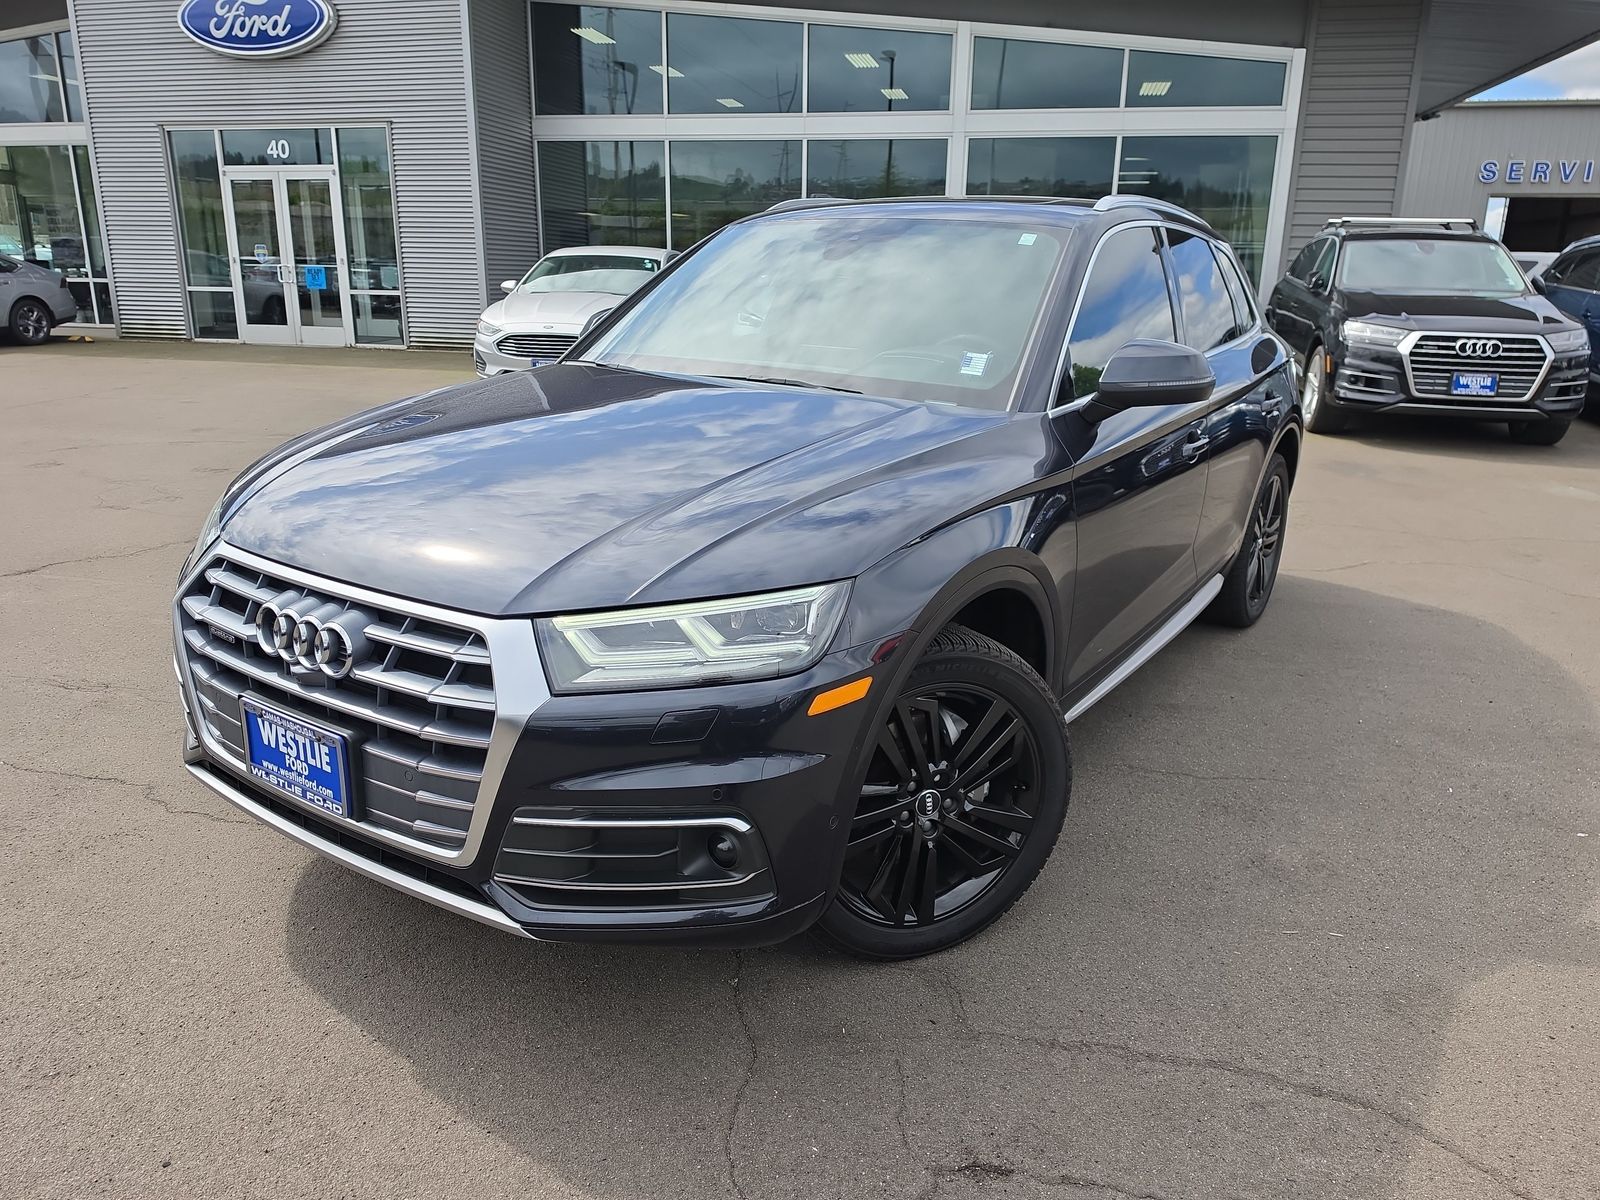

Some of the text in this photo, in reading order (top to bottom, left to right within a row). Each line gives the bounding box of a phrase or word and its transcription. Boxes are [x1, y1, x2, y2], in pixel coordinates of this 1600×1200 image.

[209, 0, 291, 39] Ford
[266, 139, 290, 159] 40
[1478, 159, 1598, 184] SERVI
[256, 717, 332, 774] WESTLIE
[261, 759, 334, 799] www.westlieford.com
[285, 754, 309, 776] FORD
